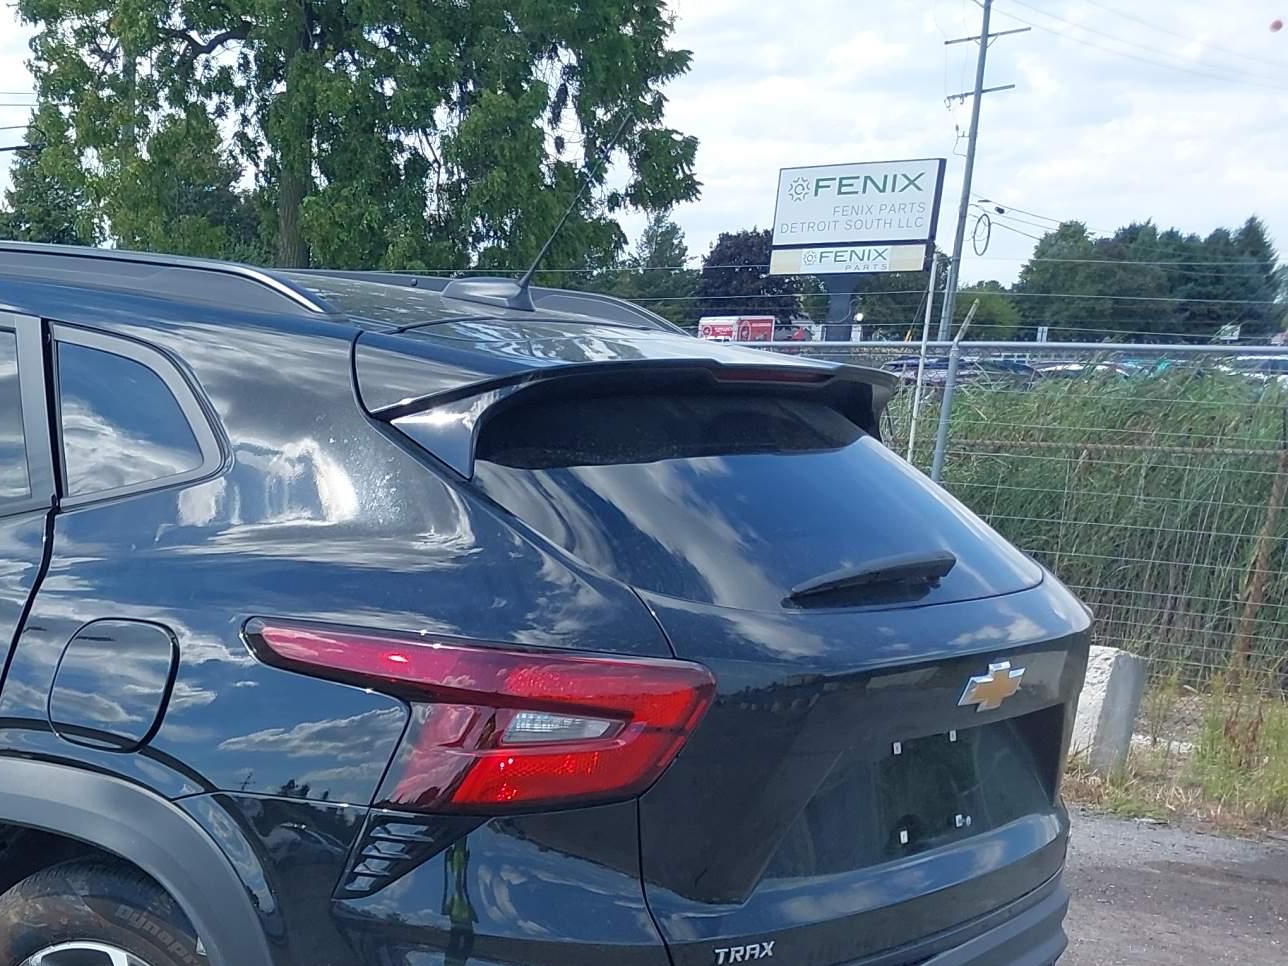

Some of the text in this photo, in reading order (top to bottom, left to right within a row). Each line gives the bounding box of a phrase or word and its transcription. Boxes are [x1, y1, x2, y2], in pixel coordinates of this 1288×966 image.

[813, 172, 926, 197] FENIX
[833, 202, 926, 217] FENIX PARTS
[780, 217, 925, 234] DETROIT SOUTH LLC
[819, 248, 889, 272] FENIX PARTS
[715, 941, 775, 965] TRAX
